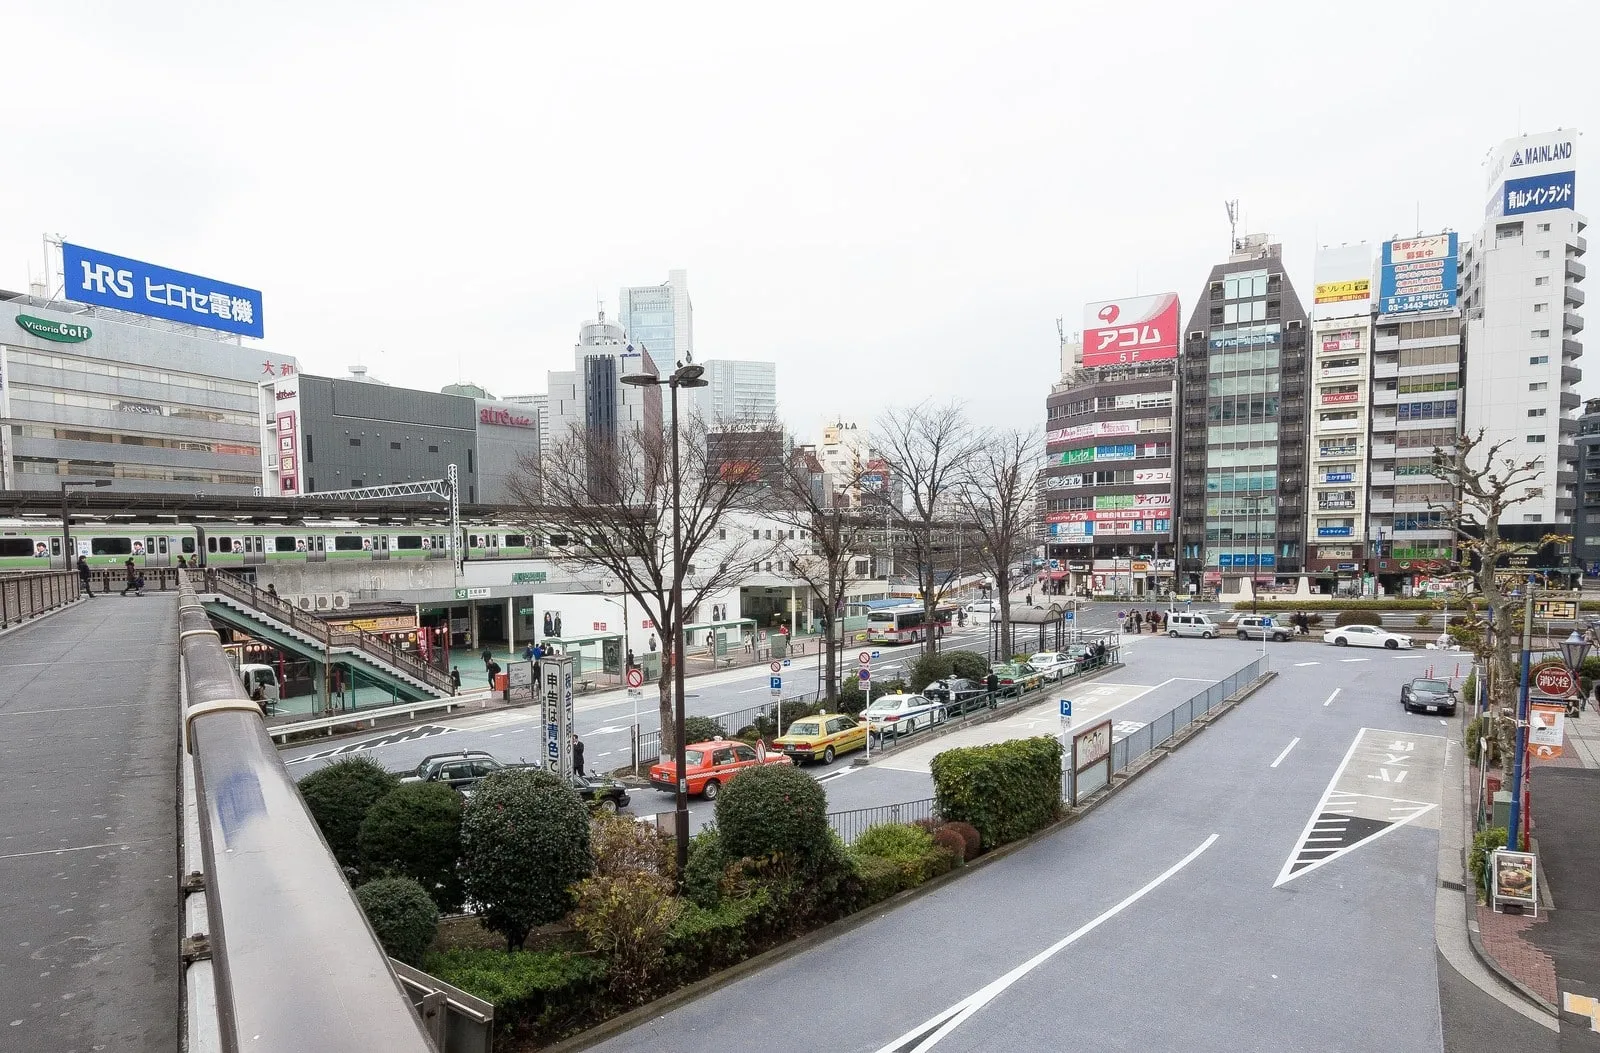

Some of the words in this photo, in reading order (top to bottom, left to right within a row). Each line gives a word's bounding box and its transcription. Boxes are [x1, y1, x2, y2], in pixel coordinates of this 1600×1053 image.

[1525, 142, 1572, 165] MAINLAND
[1508, 184, 1571, 209] 青山メインランド
[1393, 237, 1447, 251] 医療テナント
[1406, 249, 1434, 260] 募集中
[81, 260, 133, 299] HRS
[145, 277, 253, 324] ヒロセ電機
[1388, 299, 1448, 312] 03-3443-0370
[24, 320, 58, 334] Victoria
[59, 323, 89, 339] Golf
[1097, 325, 1161, 350] アコム
[1539, 675, 1570, 690] 消火栓
[1063, 702, 1070, 714] P
[547, 673, 559, 774] 申告は青色で
